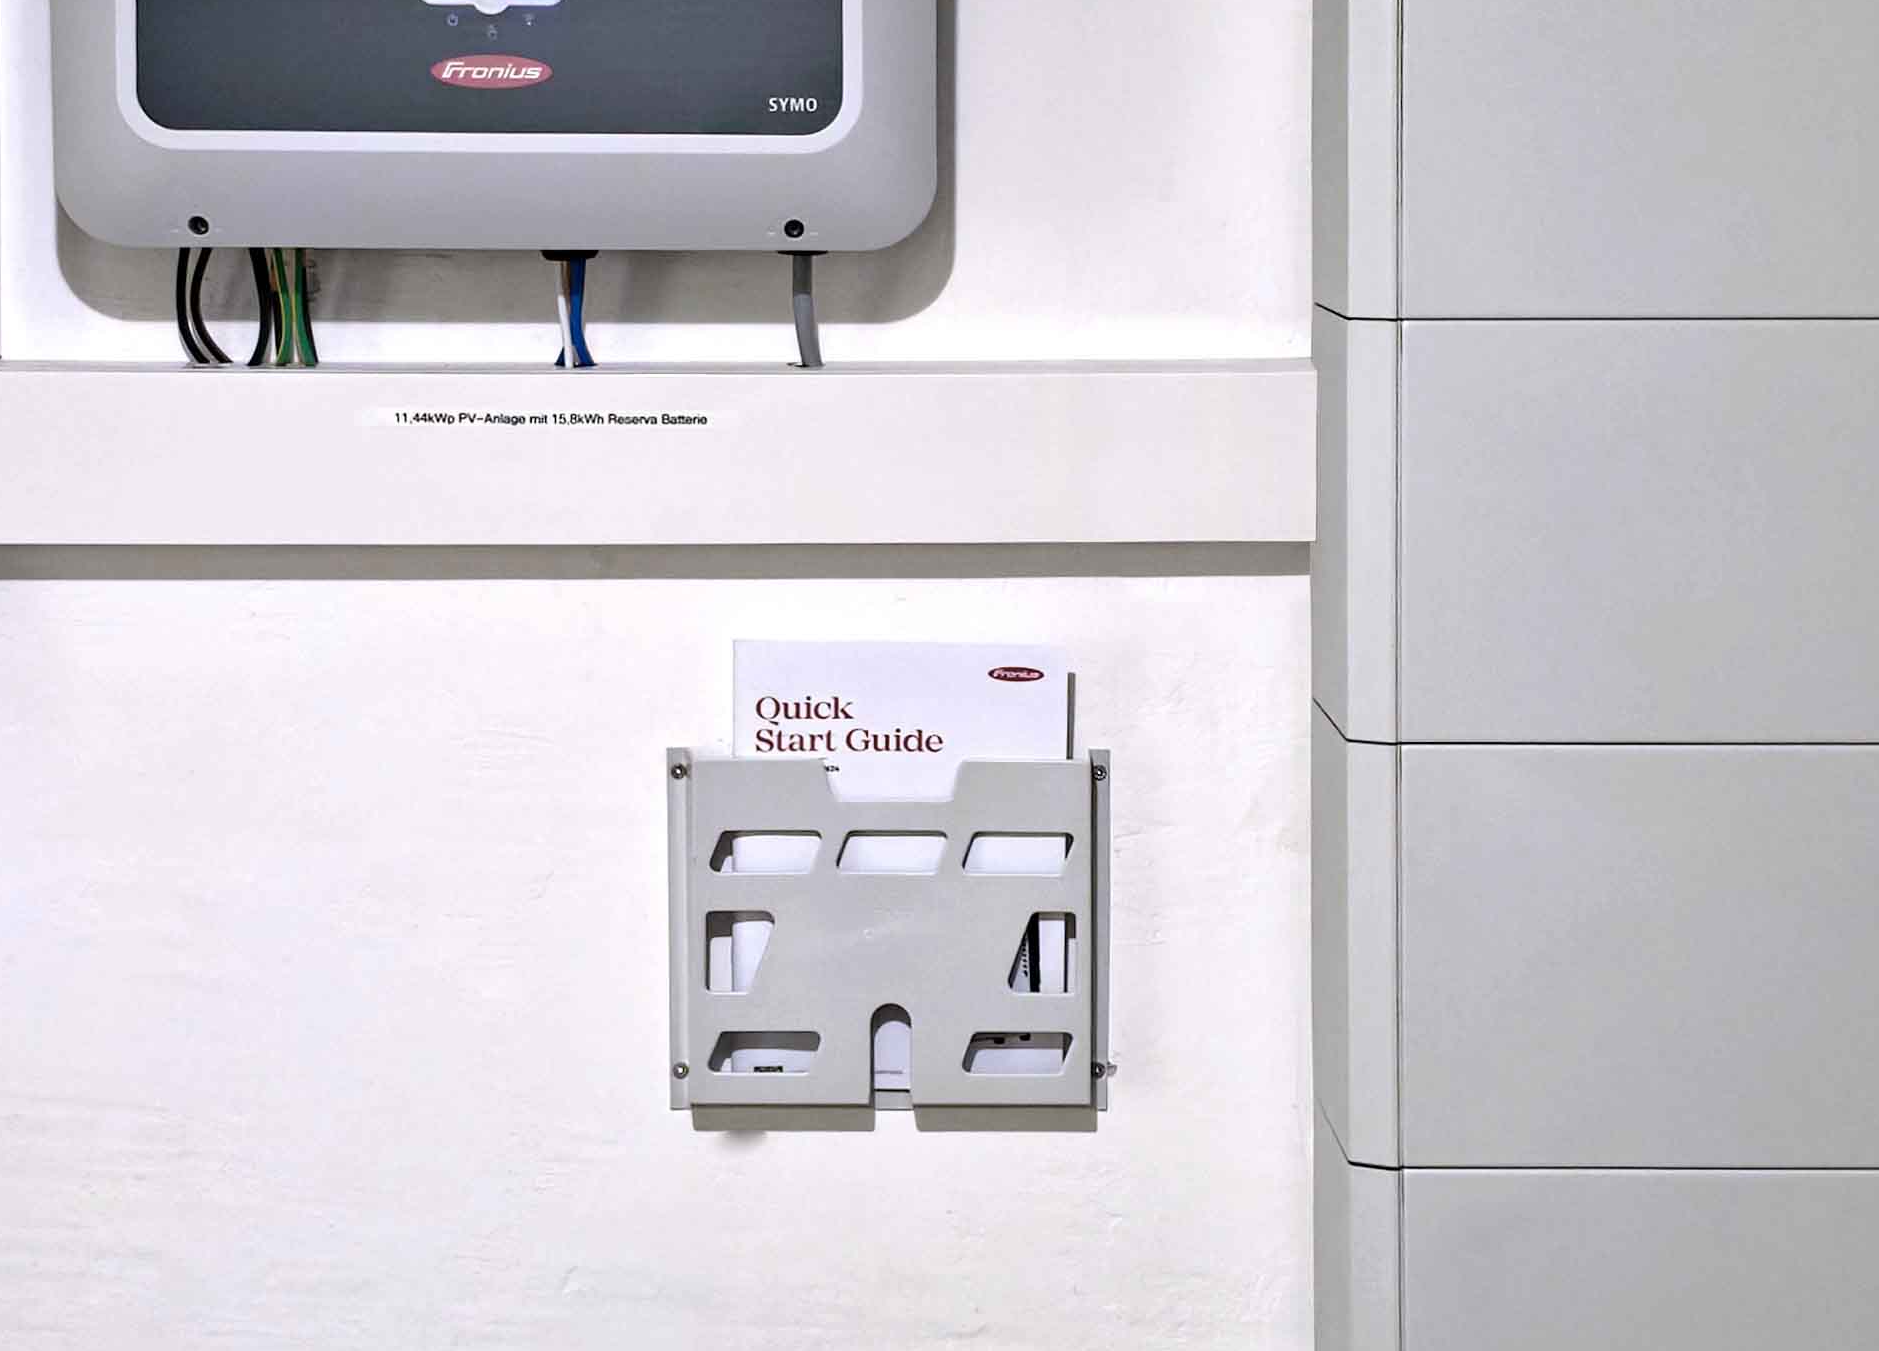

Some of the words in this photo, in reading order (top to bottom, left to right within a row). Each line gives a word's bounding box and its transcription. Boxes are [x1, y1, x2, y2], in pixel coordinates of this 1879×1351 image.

[441, 60, 543, 80] Fronius
[768, 96, 818, 113] SYMO
[394, 411, 456, 426] 11,44kWp
[458, 411, 526, 426] PV-Anlage
[530, 413, 548, 425] mit
[551, 413, 605, 426] 15,8kWh
[608, 413, 658, 425] Reserva
[661, 413, 709, 425] Batterie
[755, 695, 854, 726] Quick
[755, 728, 836, 753] Start
[846, 727, 944, 753] Guide
